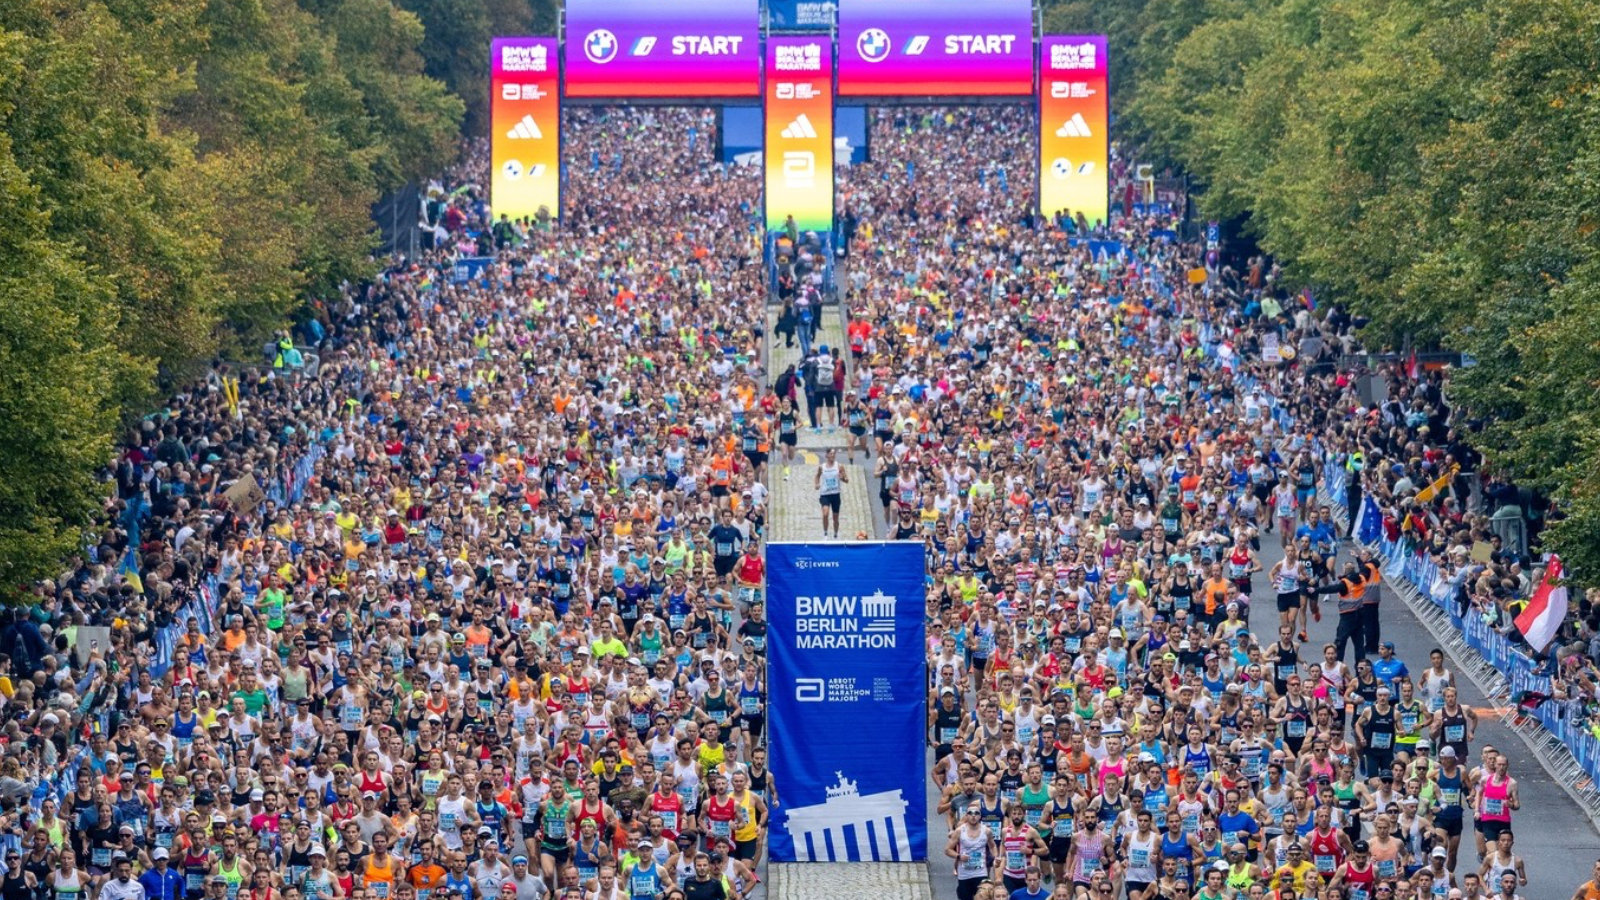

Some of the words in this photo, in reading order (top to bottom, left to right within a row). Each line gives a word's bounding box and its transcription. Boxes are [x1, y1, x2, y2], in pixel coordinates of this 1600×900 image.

[672, 36, 742, 55] START
[944, 35, 1015, 54] START
[796, 596, 857, 616] BMW
[796, 618, 858, 632] BERLIN
[796, 634, 896, 649] MARATHON
